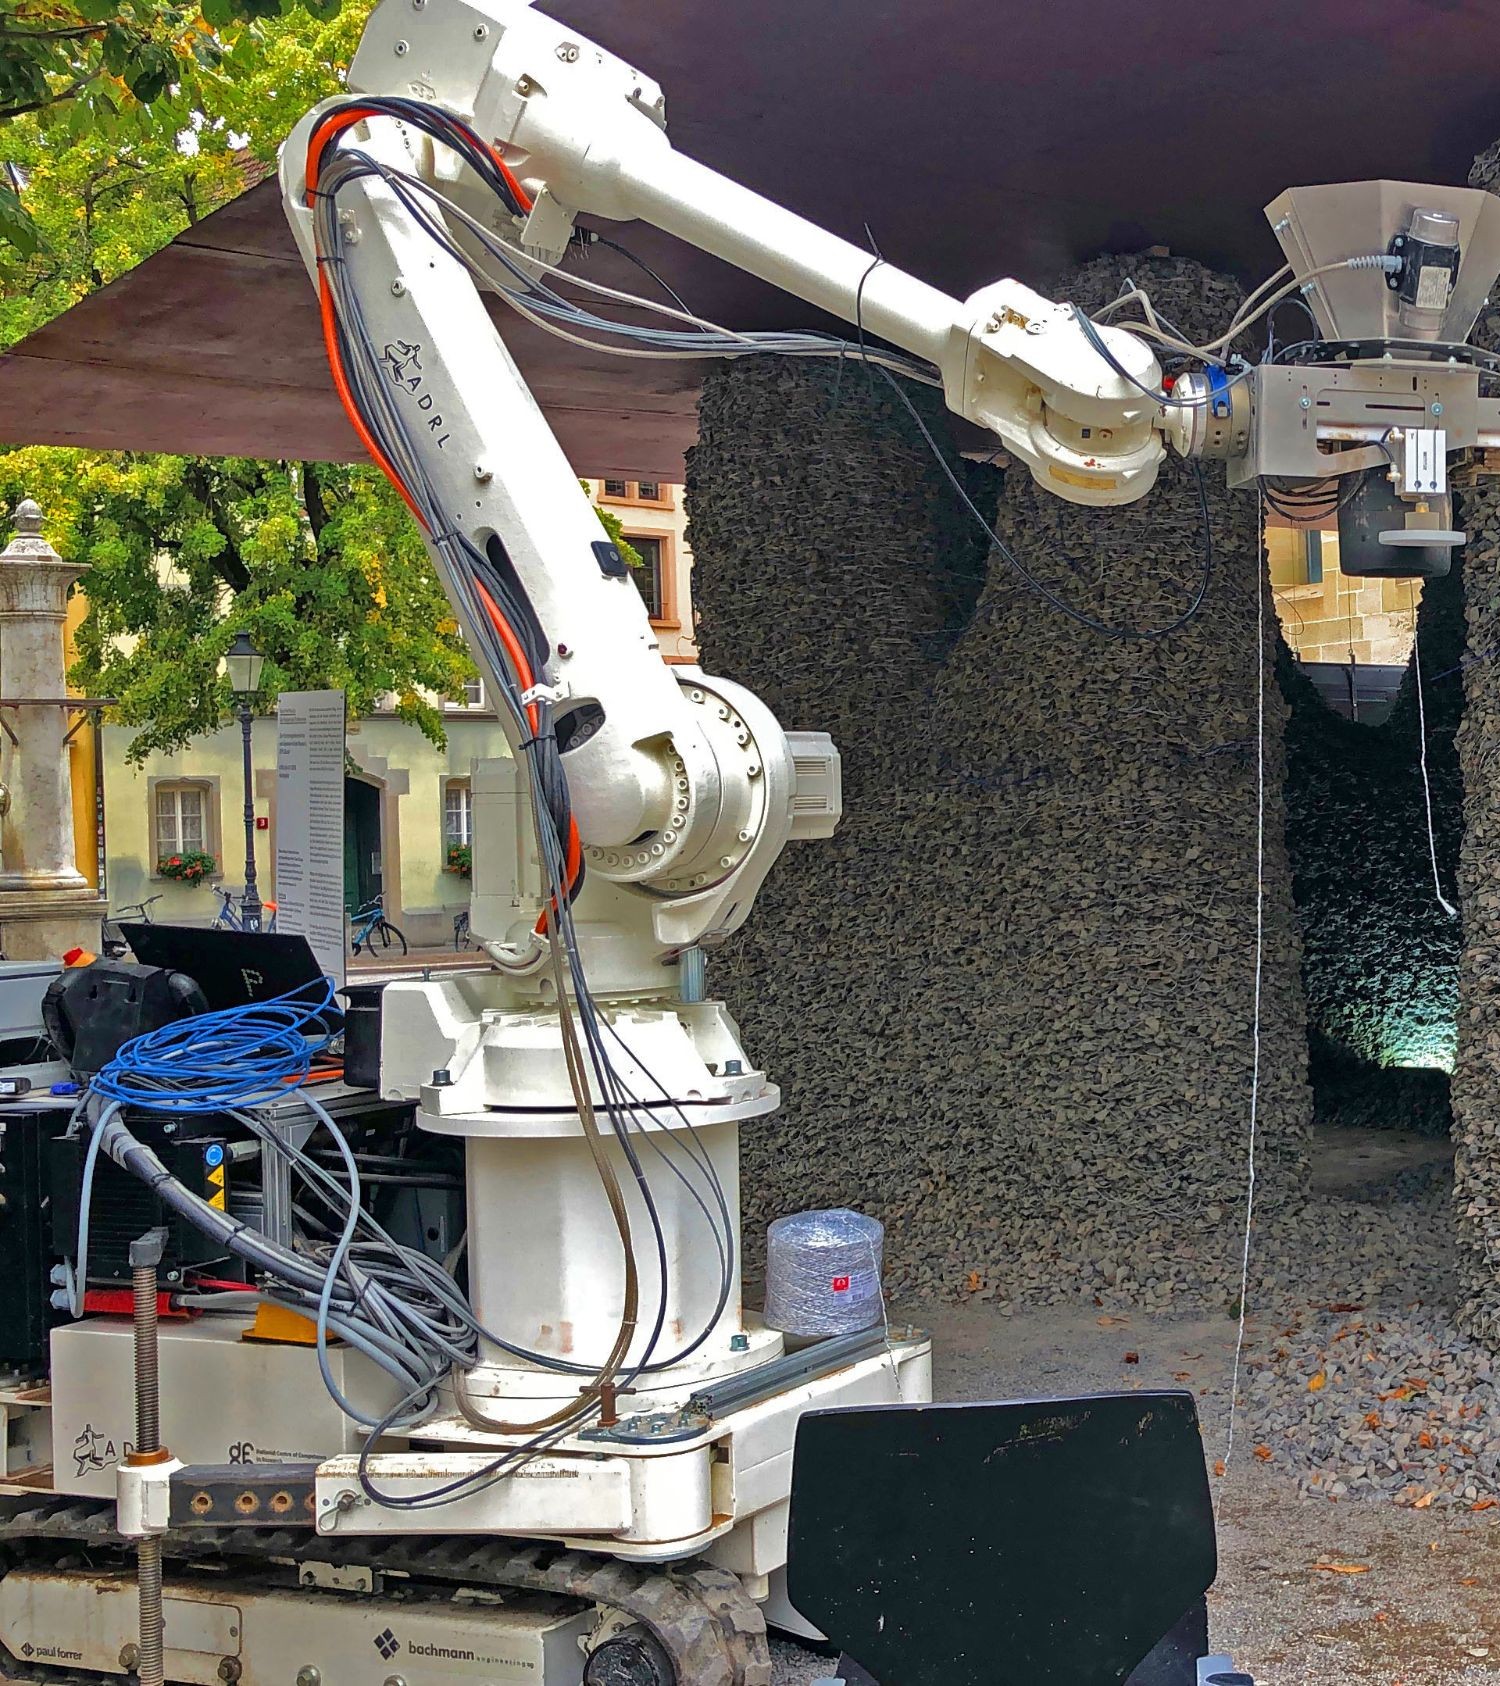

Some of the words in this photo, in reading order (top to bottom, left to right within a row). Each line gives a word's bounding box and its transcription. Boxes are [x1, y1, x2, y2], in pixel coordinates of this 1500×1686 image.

[407, 377, 450, 449] ADRL
[36, 1646, 56, 1658] paul
[57, 1647, 82, 1660] forrer
[409, 1640, 475, 1660] bachmann
